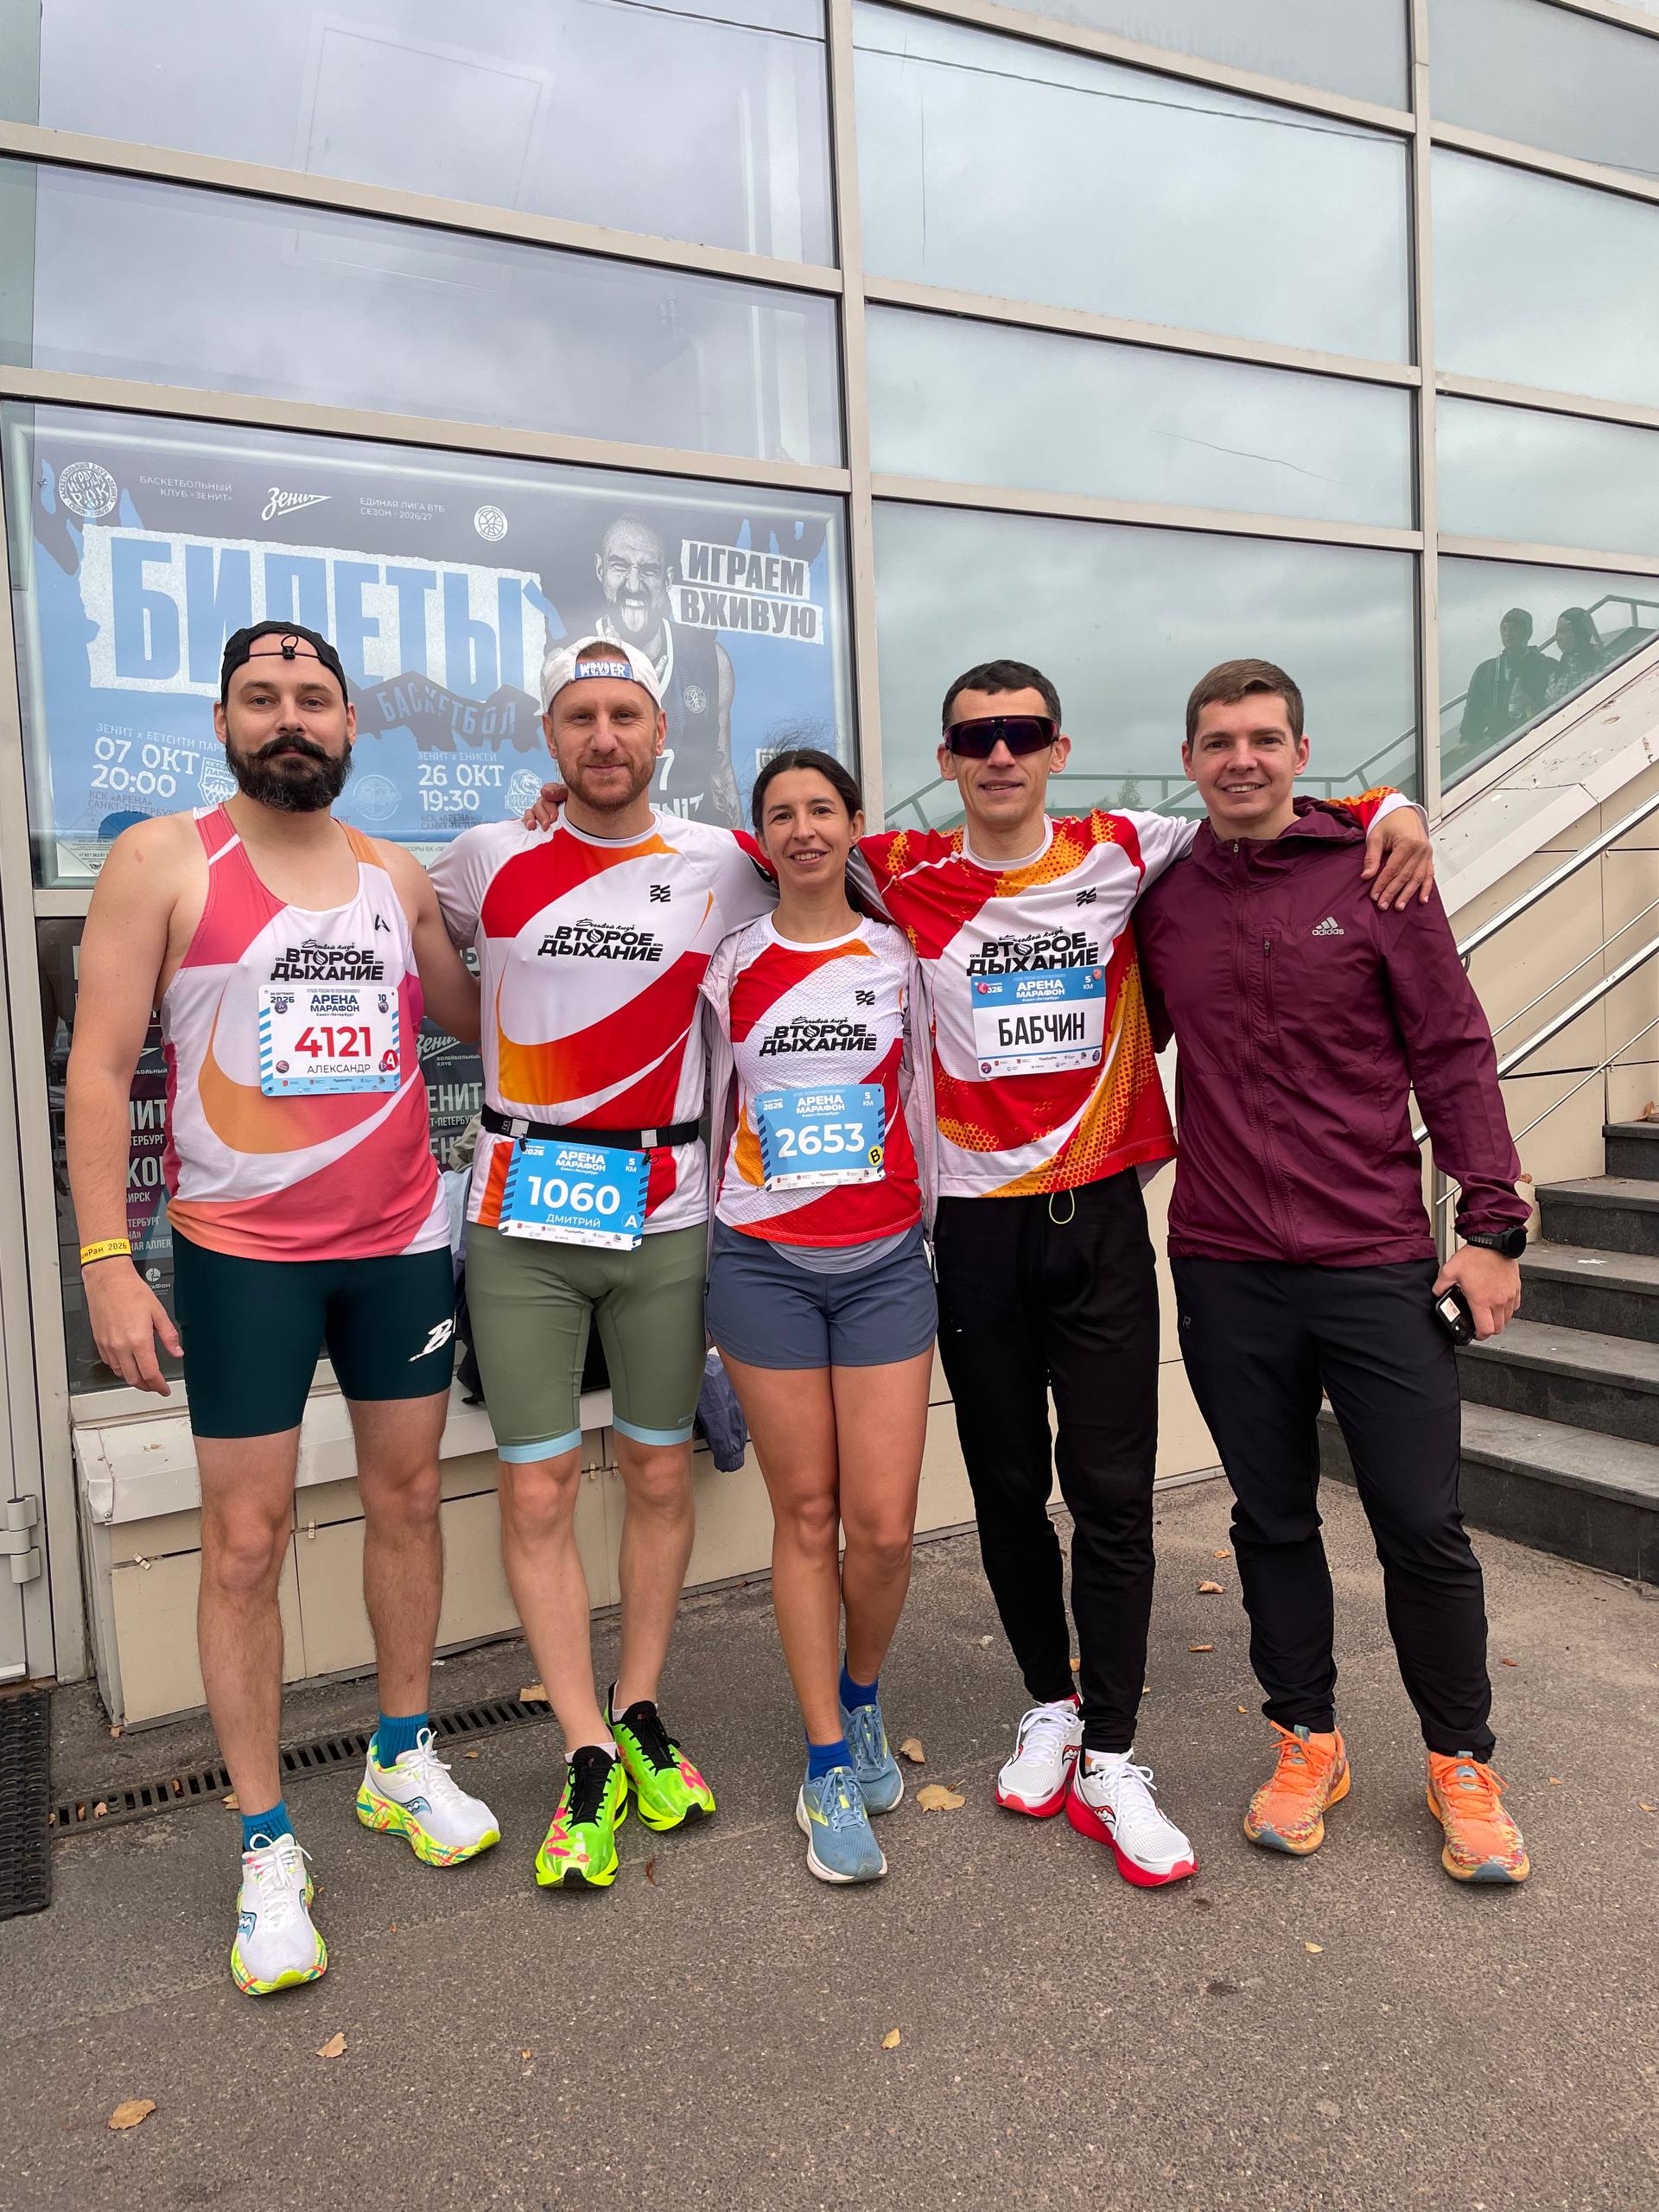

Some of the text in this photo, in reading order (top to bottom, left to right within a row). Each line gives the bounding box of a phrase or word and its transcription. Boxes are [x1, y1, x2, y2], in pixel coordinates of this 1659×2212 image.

[140, 475, 232, 492] БАСКЕТБОЛЬНЫЙ
[161, 488, 233, 502] КЛУБ «ЗЕНИТ»
[359, 497, 445, 512] ЕДИНАЯ ЛИГА ВТБ
[360, 507, 391, 518] СЕЗОН
[688, 543, 804, 596] ИГРАЕМ
[111, 537, 524, 694] БИЛЕТЫ
[680, 588, 817, 639] ВЖИВУЮ
[377, 682, 516, 734] БАСКЕТБОЛ
[96, 723, 134, 738] ЗЕНИТ
[95, 736, 200, 774] 07 ОКТ
[417, 752, 448, 761] ЗЕНИТ
[460, 752, 497, 761] ЕНИСЕЙ
[91, 764, 176, 798] 20:00
[417, 764, 505, 787] 26 ОКТ
[89, 790, 152, 805] КСК «АРЕНА»
[419, 790, 480, 811] 19:30
[88, 799, 181, 817] САНКТ-ПЕТЕРБУР
[555, 925, 654, 946] ВТОРОЕ
[982, 931, 1087, 957] ВТОРОЕ
[285, 948, 374, 965] ВТОРОЕ
[537, 939, 664, 962] ДЫХАНИЕ
[966, 947, 1098, 976] ДЫХАНИЕ
[270, 963, 384, 982] ДЫХАНИЕ
[1018, 979, 1064, 990] АРЕНА
[311, 995, 358, 1005] АРЕНА
[1016, 988, 1065, 999] МАРАФОН
[773, 1024, 867, 1039] ВТОРОЕ
[998, 1012, 1085, 1046] БАБЧИН
[295, 1026, 372, 1058] 4121
[759, 1037, 877, 1057] ДЫХАНИЕ
[307, 1064, 371, 1074] АЛЕКСАНДР
[386, 1054, 397, 1069] A
[426, 1082, 482, 1112] ЕНИТ
[798, 1095, 843, 1107] АРЕНА
[763, 1102, 784, 1110] 2026
[797, 1104, 845, 1114] МАРАФОН
[775, 1122, 865, 1158] 2653
[557, 1150, 606, 1164] АРЕНА
[870, 1148, 880, 1163] B
[556, 1159, 606, 1172] МАРАФОН
[527, 1176, 620, 1215] 1060
[546, 1213, 601, 1228] ДМИТРИЙ
[625, 1215, 638, 1229] A
[108, 1242, 127, 1251] 2026
